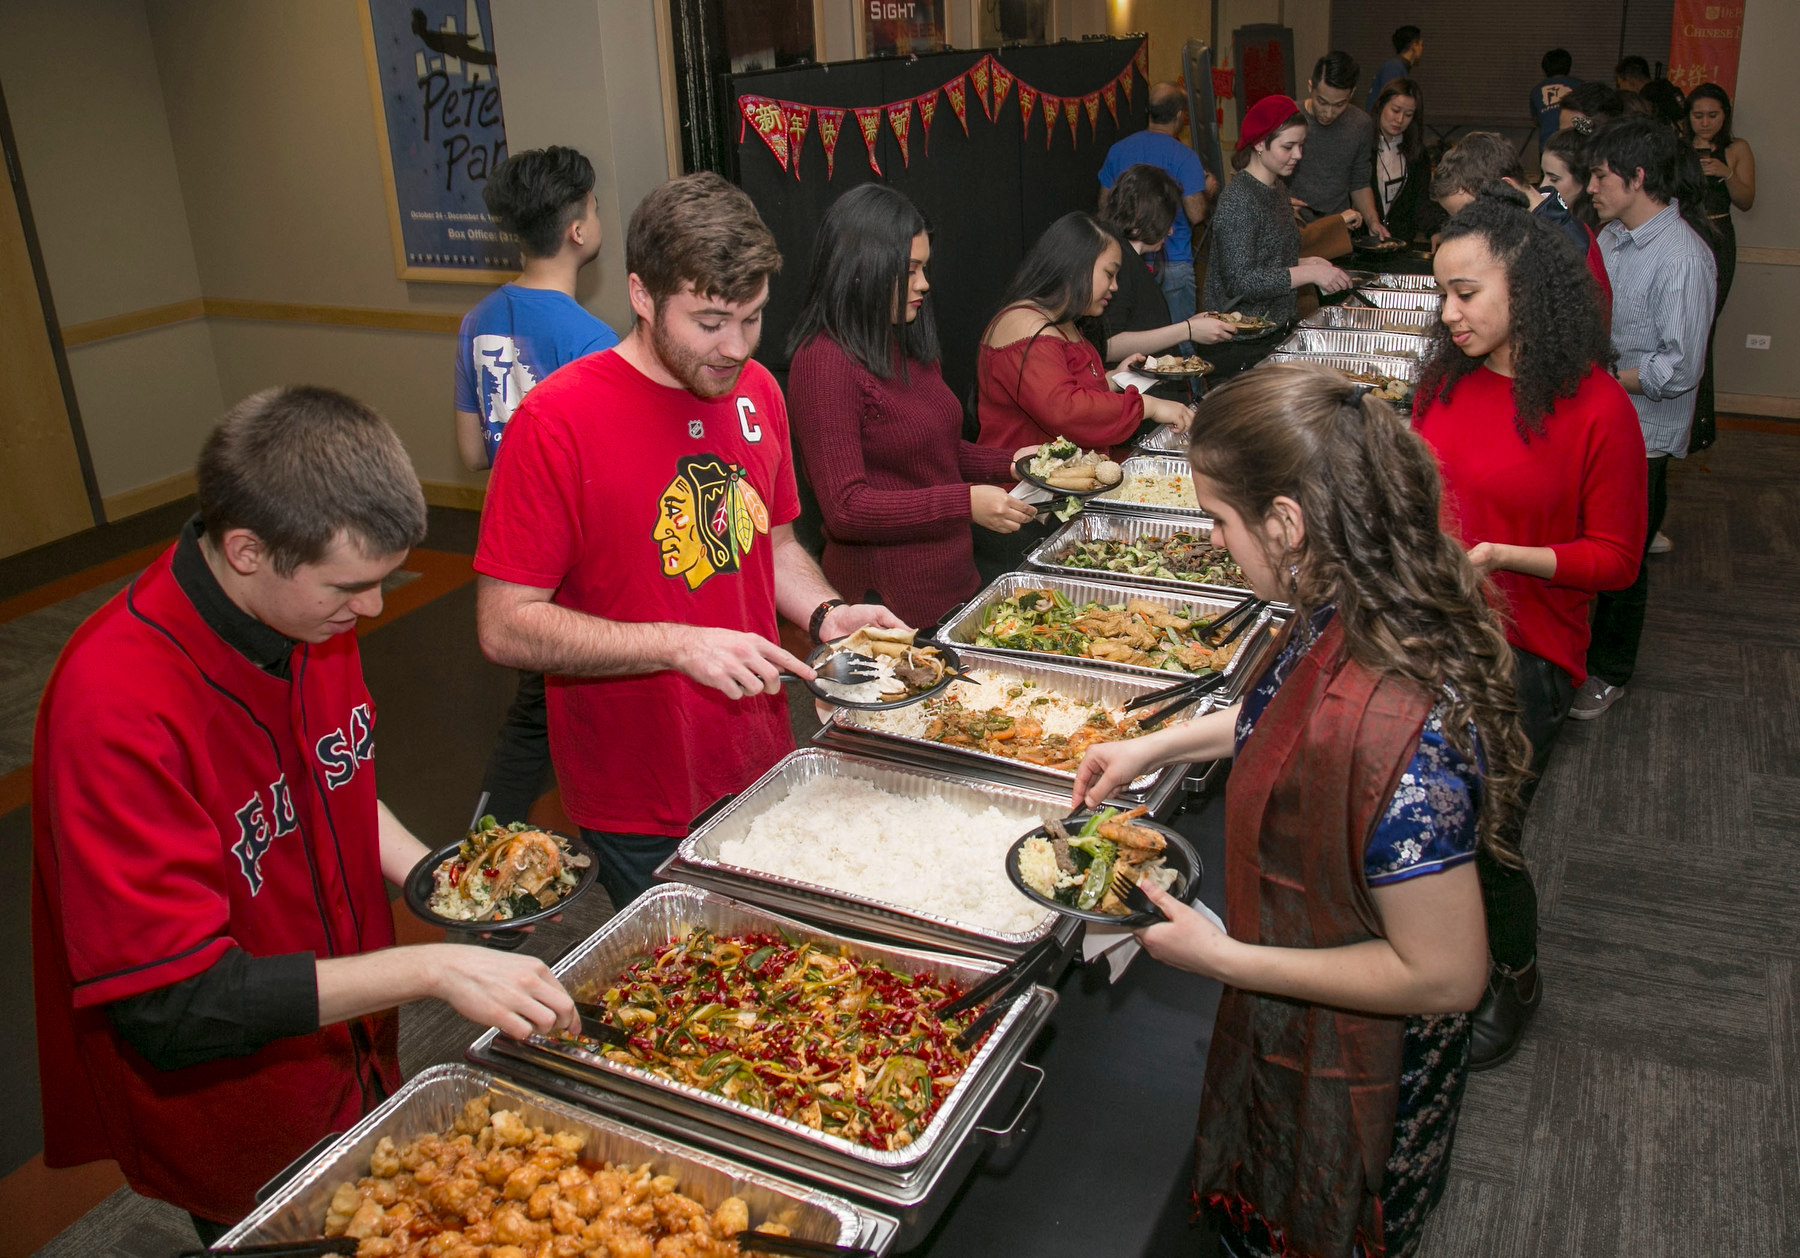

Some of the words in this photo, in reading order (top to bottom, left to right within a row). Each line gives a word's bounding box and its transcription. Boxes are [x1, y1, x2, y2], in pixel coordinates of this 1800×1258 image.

[870, 1, 916, 20] SIGHT
[1683, 24, 1733, 39] CHINESE
[417, 69, 506, 144] Pete
[754, 103, 783, 133] 新
[789, 113, 805, 141] 年
[821, 119, 836, 145] 快
[410, 209, 433, 220] October
[447, 211, 479, 222] December
[448, 227, 465, 239] Box
[736, 395, 763, 443] C
[315, 703, 377, 790] SX
